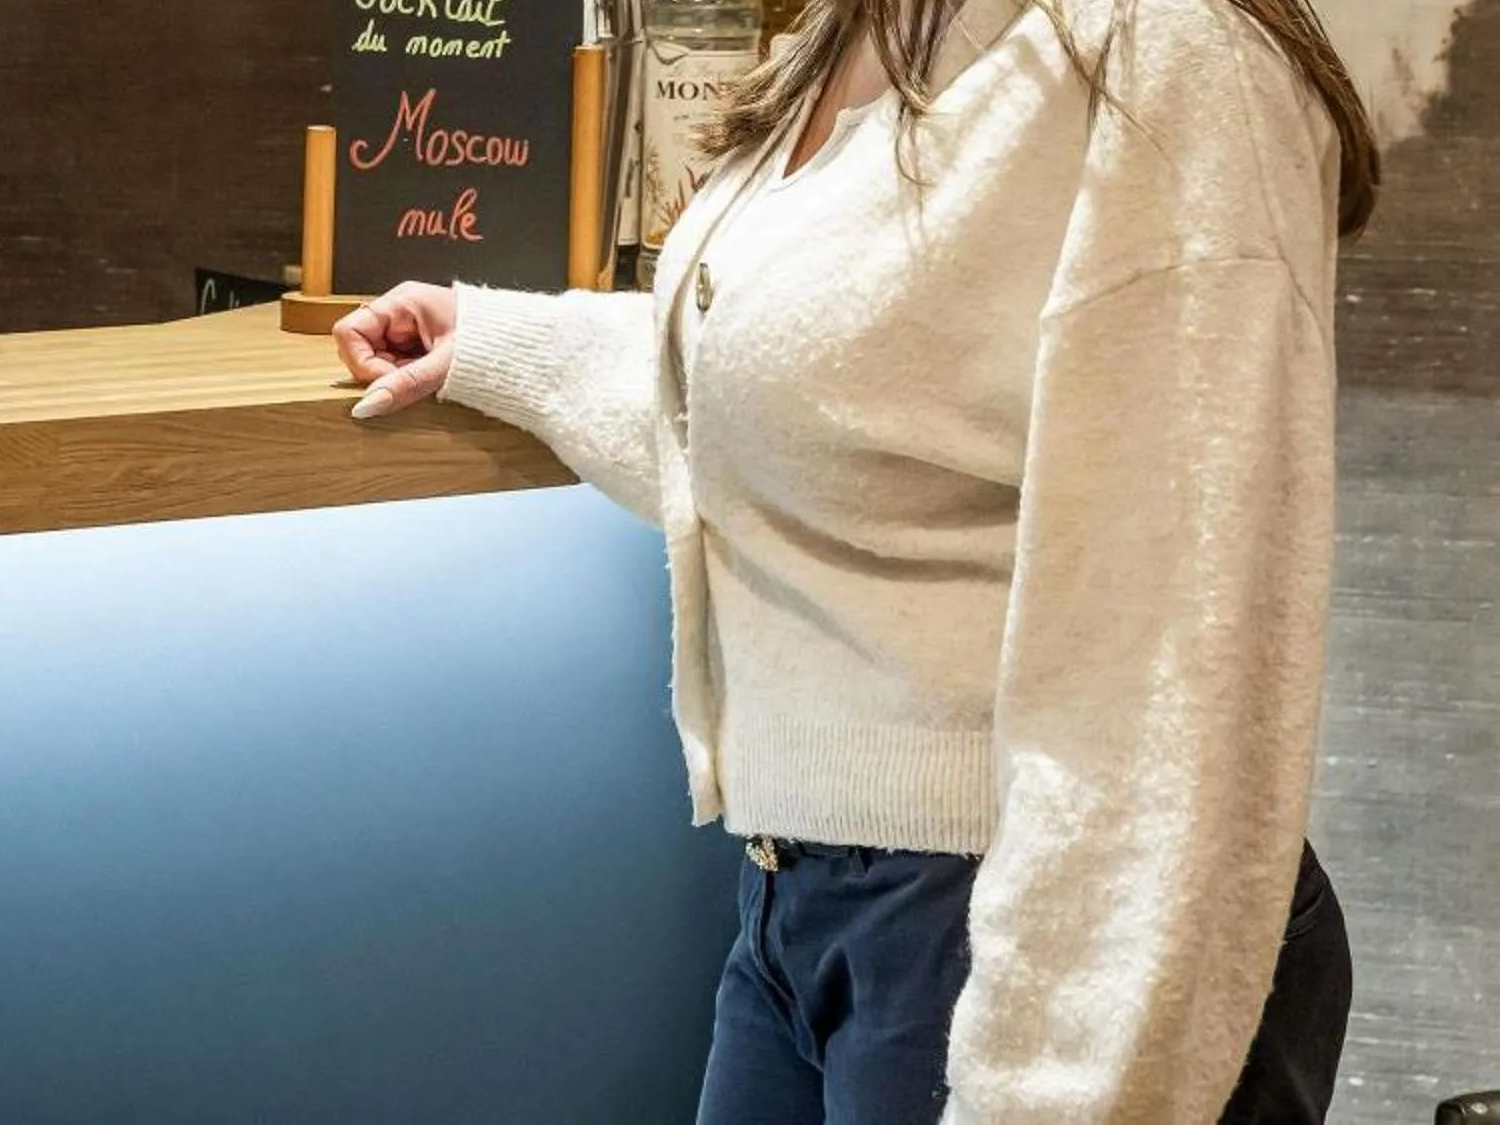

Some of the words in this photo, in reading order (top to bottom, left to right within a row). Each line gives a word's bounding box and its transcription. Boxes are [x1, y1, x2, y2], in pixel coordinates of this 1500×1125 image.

[351, 19, 388, 53] du
[404, 27, 512, 60] moment
[656, 79, 720, 101] MON
[349, 87, 530, 169] Moscow
[396, 186, 485, 242] mule
